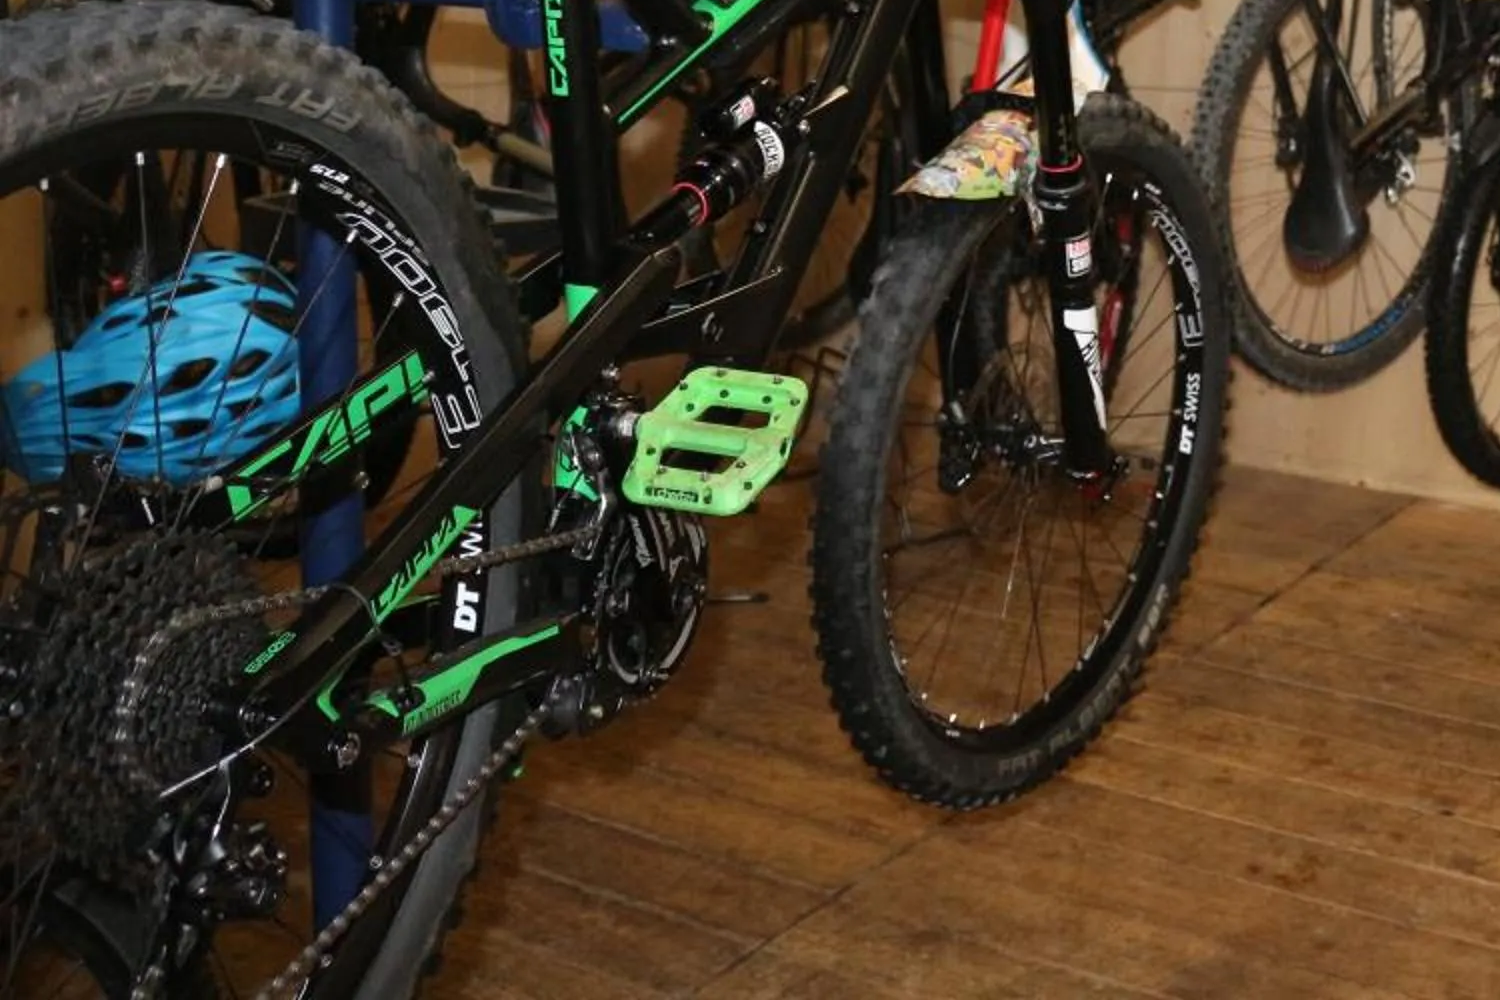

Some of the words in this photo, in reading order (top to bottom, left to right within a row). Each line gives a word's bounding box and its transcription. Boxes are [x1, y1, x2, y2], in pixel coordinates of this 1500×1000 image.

[1182, 372, 1201, 423] SWISS
[1179, 423, 1197, 455] DT
[453, 580, 480, 633] DT
